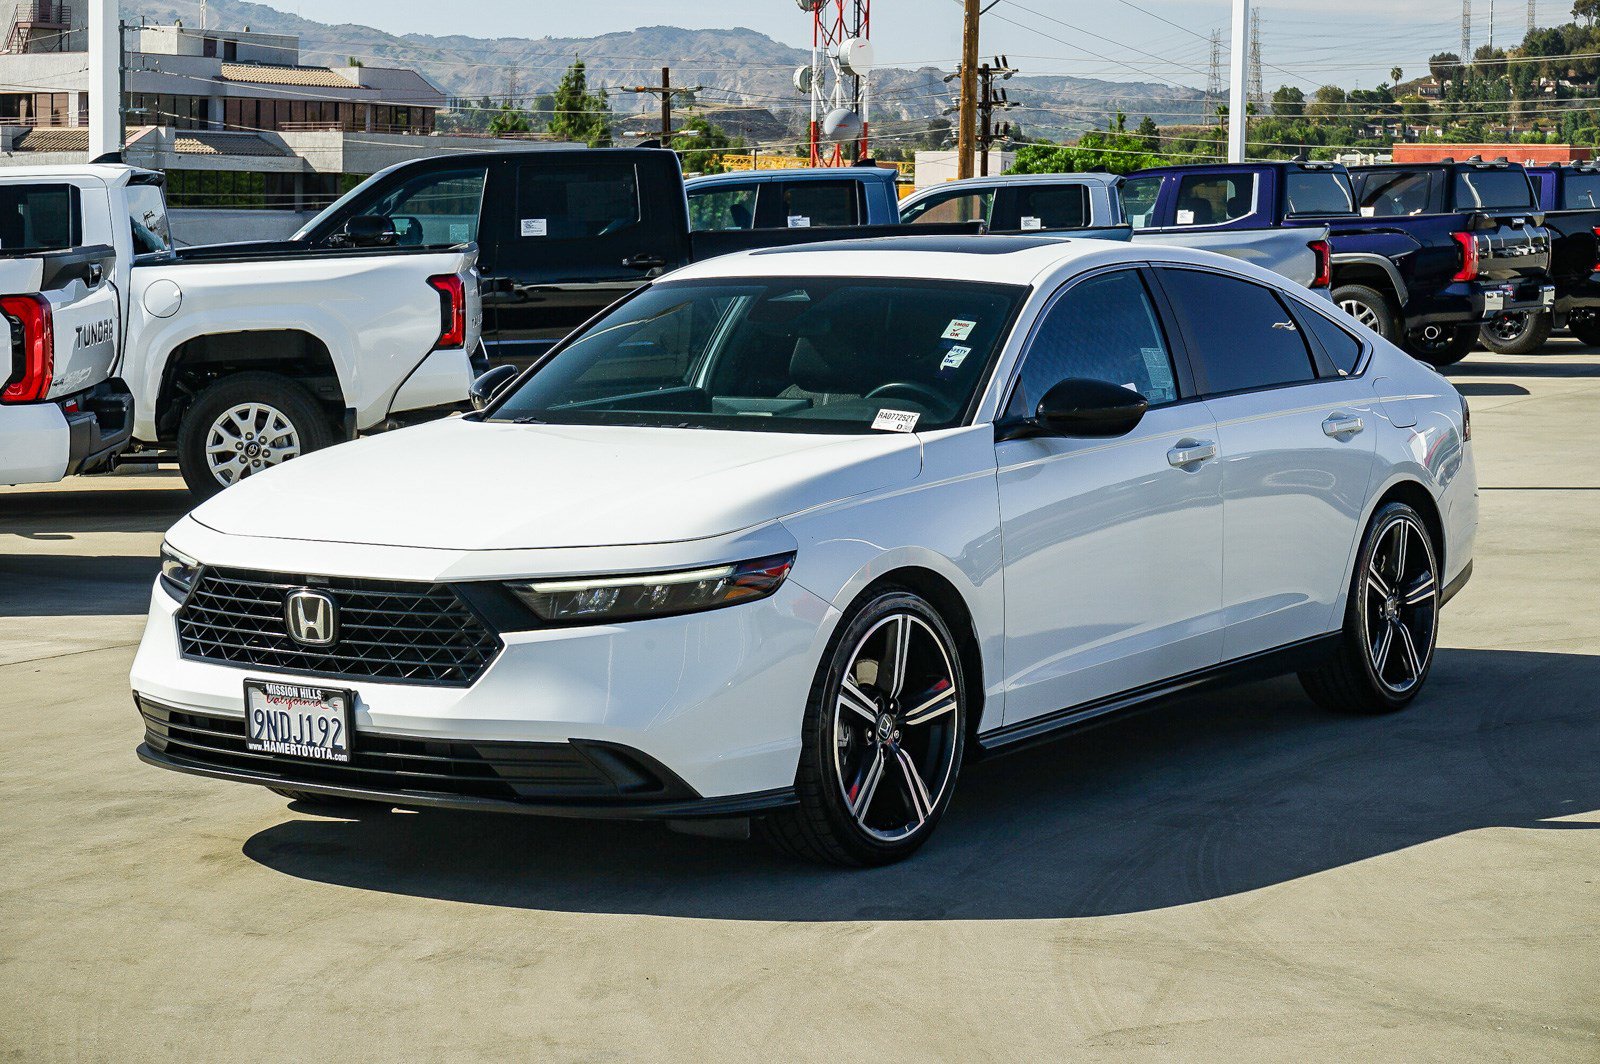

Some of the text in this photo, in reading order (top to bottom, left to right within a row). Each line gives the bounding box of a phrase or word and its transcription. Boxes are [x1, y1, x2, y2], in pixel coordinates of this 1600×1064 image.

[75, 318, 113, 349] TUNDRA
[265, 683, 323, 700] MISSION HILLS
[266, 694, 329, 711] California
[253, 708, 344, 750] 9NDJ192
[248, 740, 349, 762] www.HAMERTOYOTA.com
